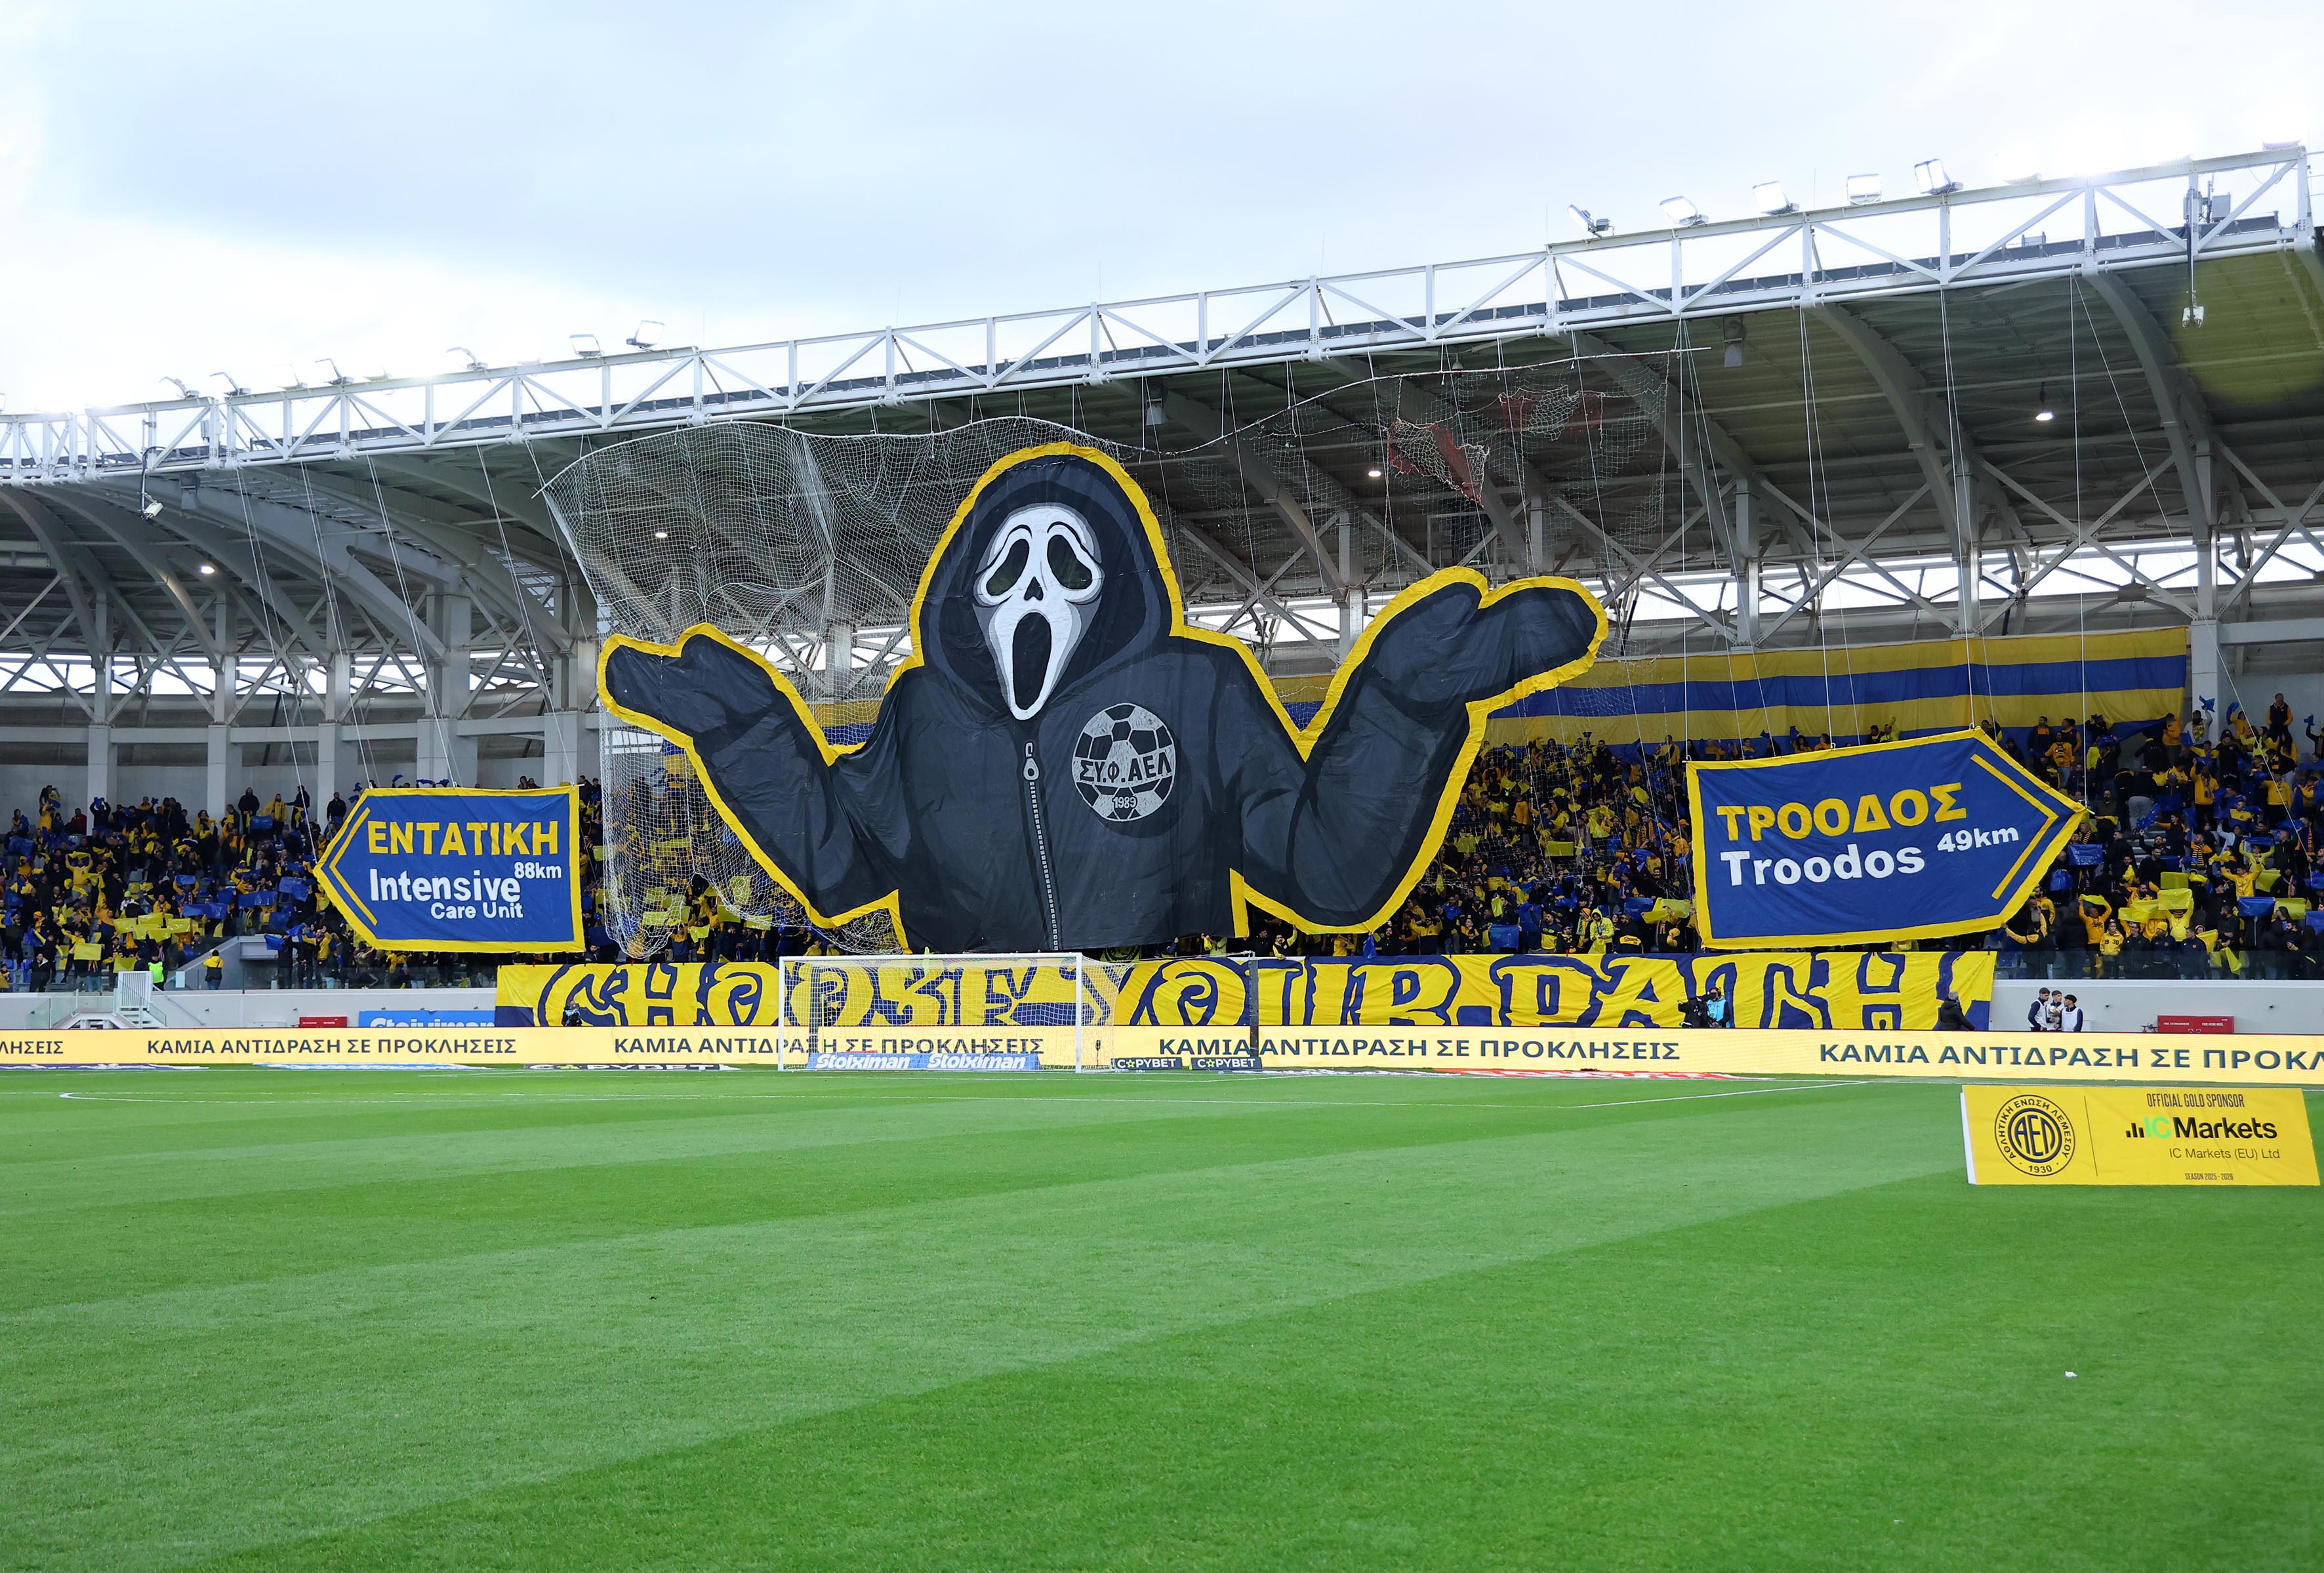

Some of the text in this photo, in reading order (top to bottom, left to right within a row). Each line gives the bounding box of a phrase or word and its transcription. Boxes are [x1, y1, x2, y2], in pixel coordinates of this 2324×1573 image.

[1112, 796, 1137, 809] 1989
[1716, 783, 1967, 841] ΤΡΟΟΔΟΣ
[367, 821, 558, 856] ΕΝΤΑΤΙΚΗ
[1937, 827, 2019, 853] 49km
[514, 862, 562, 880] 88km
[1720, 844, 1925, 886] Troodos
[369, 868, 521, 903] Intensive
[430, 901, 523, 919] Care Unit
[148, 1040, 516, 1053] ΚΑΜΙΑ ΑΝΤΙΔΡΑΣΗ ΣΕ ΠΡΟΚΛΗΣΕΙΣ
[615, 1039, 692, 1052] ΚΑΜΙΑ
[882, 1039, 1044, 1053] ΠΡΟΚΛΗΣΕΙΣ
[1160, 1040, 1679, 1059] ΚΑΜΙΑ ΑΝΤΙΔΡΑΣΗ ΣΕ ΠΡΟΚΛΗΣΕΙΣ
[815, 1053, 911, 1069] Stoiximan
[927, 1053, 1027, 1069] Stoiximan
[1820, 1044, 1928, 1063] ΚΑΜΙΑ
[1939, 1046, 2138, 1067] ΑΝΤΙΔΡΑΣΗ
[2151, 1050, 2190, 1068] ΣΕ
[2147, 1093, 2245, 1107] OFFICIAL GOLD SPONSOR
[1999, 1099, 2072, 1159] ΑΘΛΗΤΙΚΗ ΕΝΩΣΗ ΛΕΜΕΣΟΥ
[2169, 1149, 2280, 1160] IC Markets (EU) Ltd
